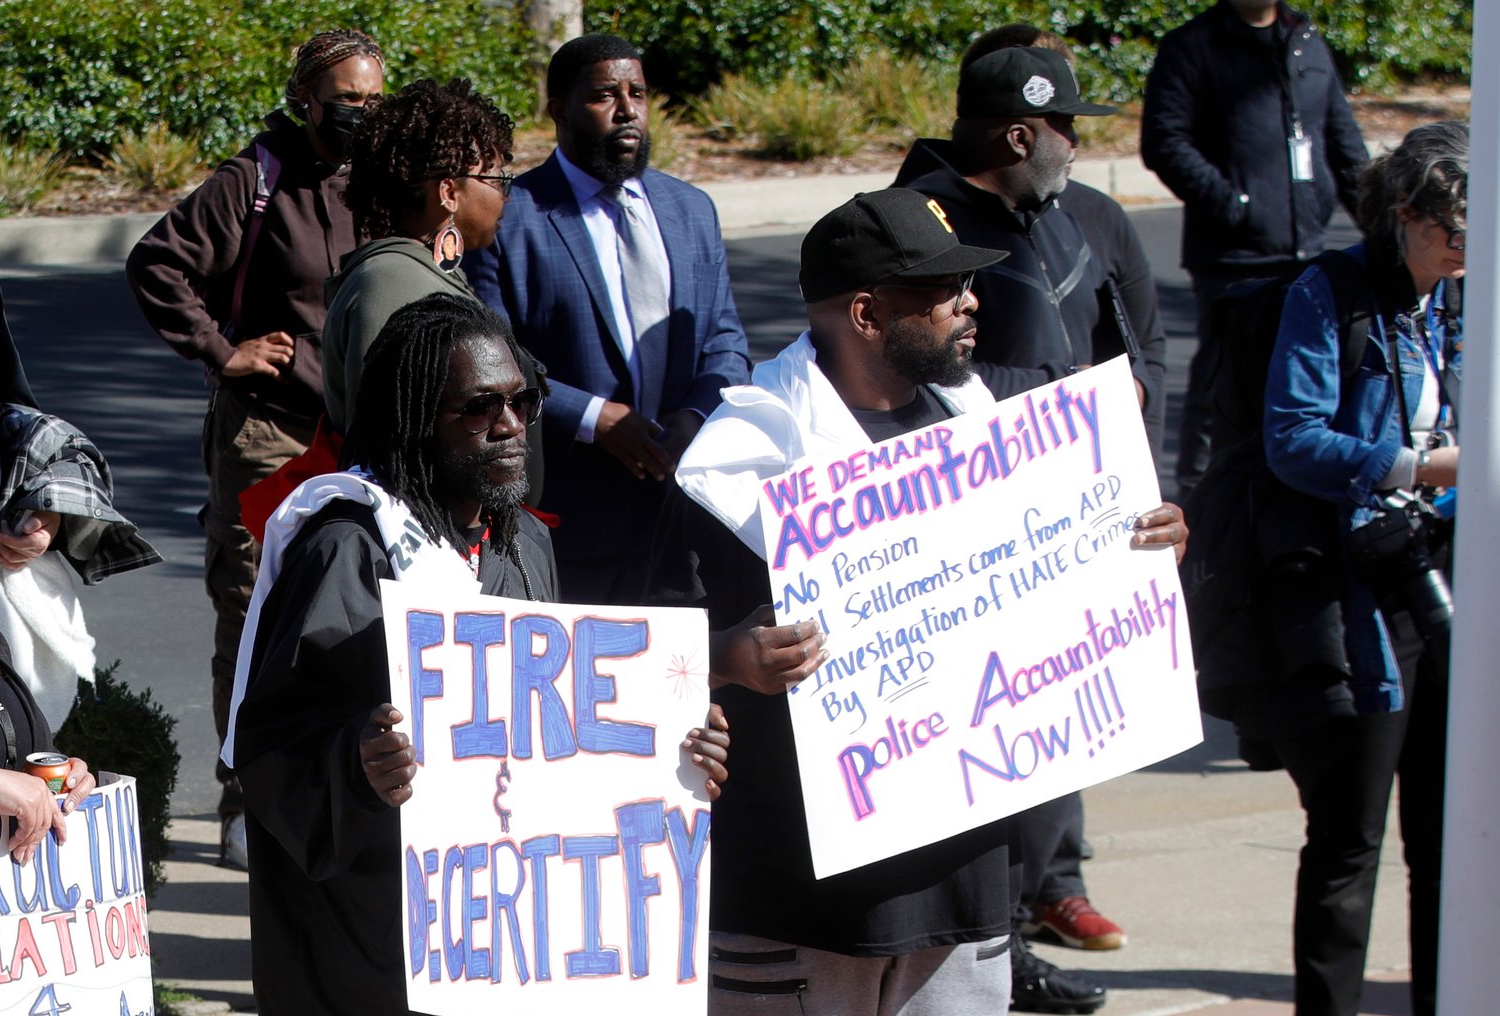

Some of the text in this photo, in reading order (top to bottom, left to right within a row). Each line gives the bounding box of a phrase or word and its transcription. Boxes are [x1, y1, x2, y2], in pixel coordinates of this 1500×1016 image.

[762, 425, 954, 517] WE DEMAND
[810, 606, 968, 698] Investigation
[974, 574, 1003, 612] of
[1008, 543, 1070, 600] HATE
[831, 535, 919, 588] Pension
[844, 557, 964, 630] Settlements
[1022, 507, 1073, 554] from
[1080, 475, 1121, 520] APD
[405, 608, 658, 768] FIRE
[821, 650, 935, 735] By APD
[404, 796, 712, 986] DECERTIFY
